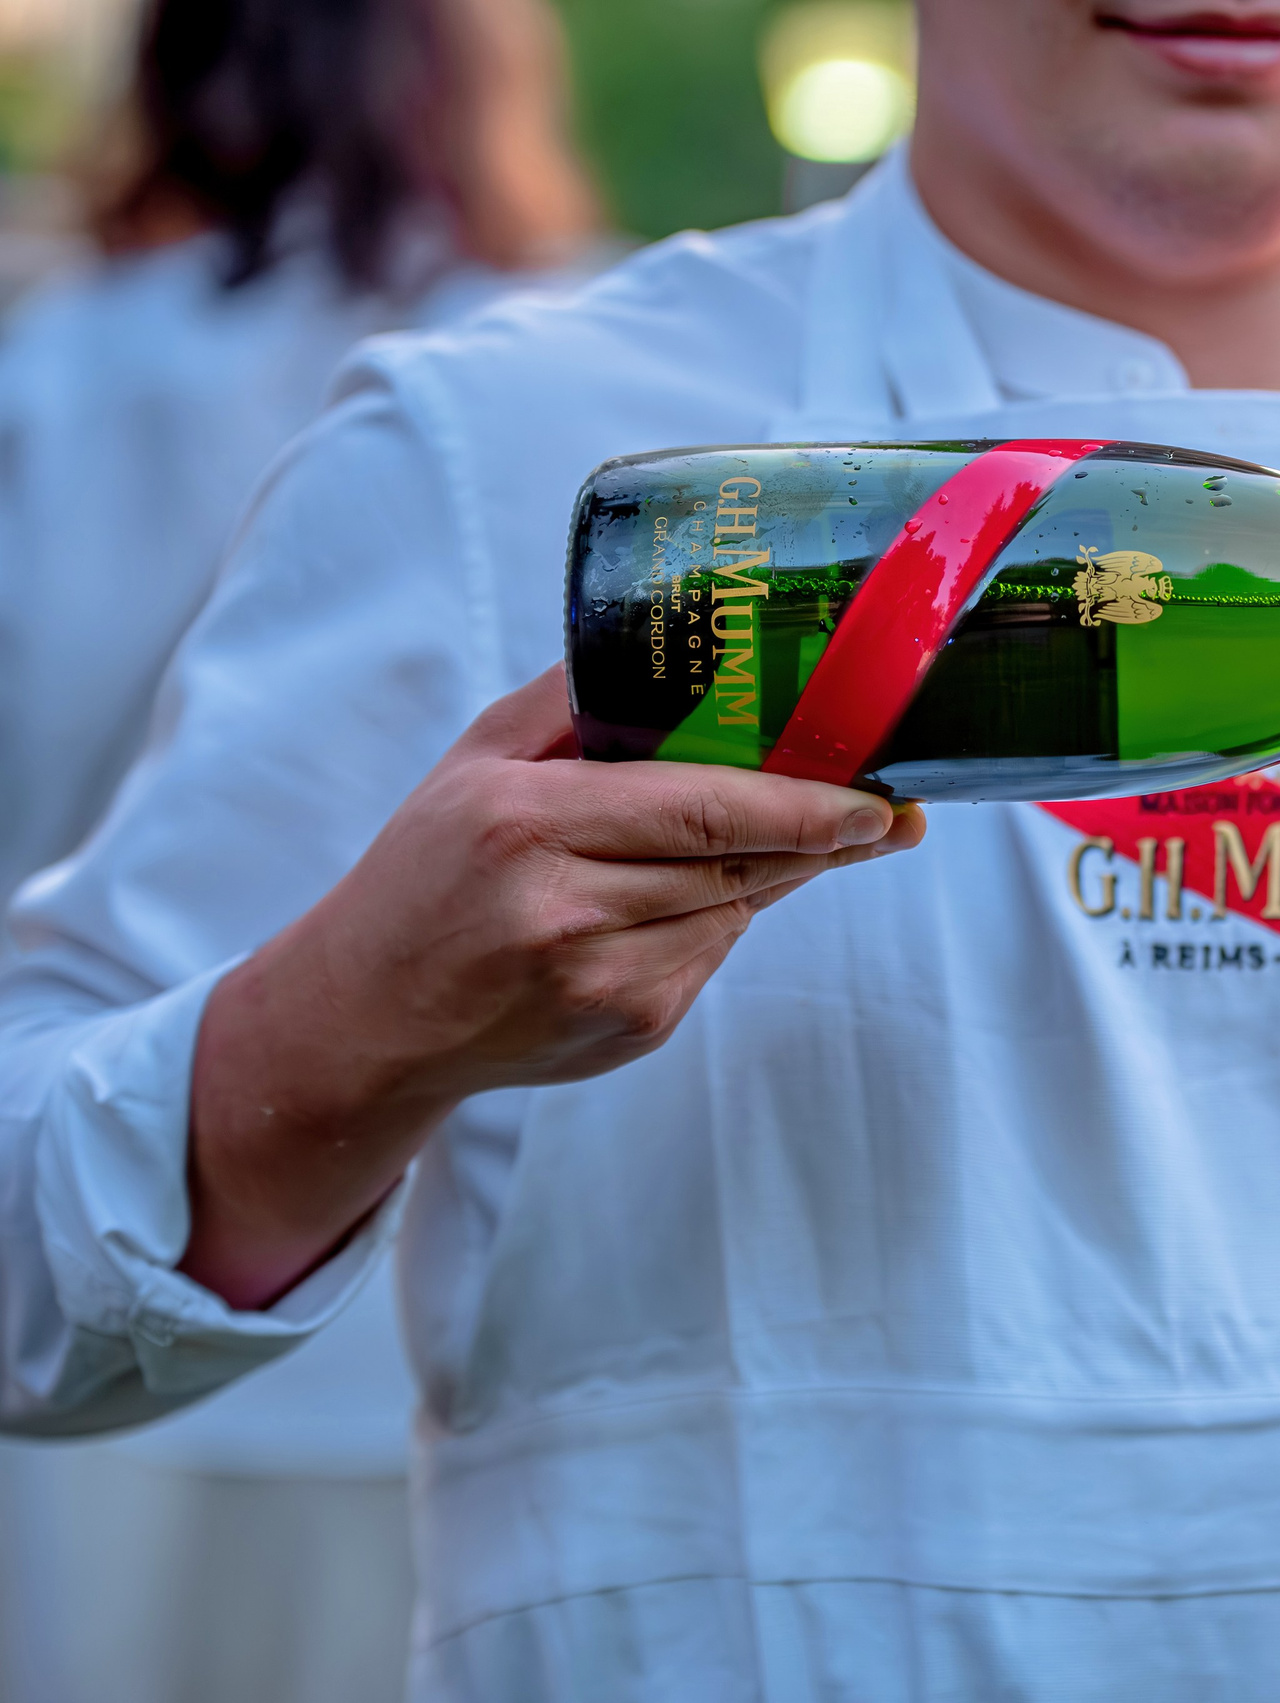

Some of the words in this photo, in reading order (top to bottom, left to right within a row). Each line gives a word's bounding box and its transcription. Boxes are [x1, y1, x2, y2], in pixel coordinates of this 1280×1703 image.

[651, 516, 669, 585] GRAND
[671, 574, 682, 614] BRUT
[687, 500, 707, 696] CHAMPAGNE
[649, 590, 667, 679] CORDON
[1151, 942, 1265, 970] REIMS
